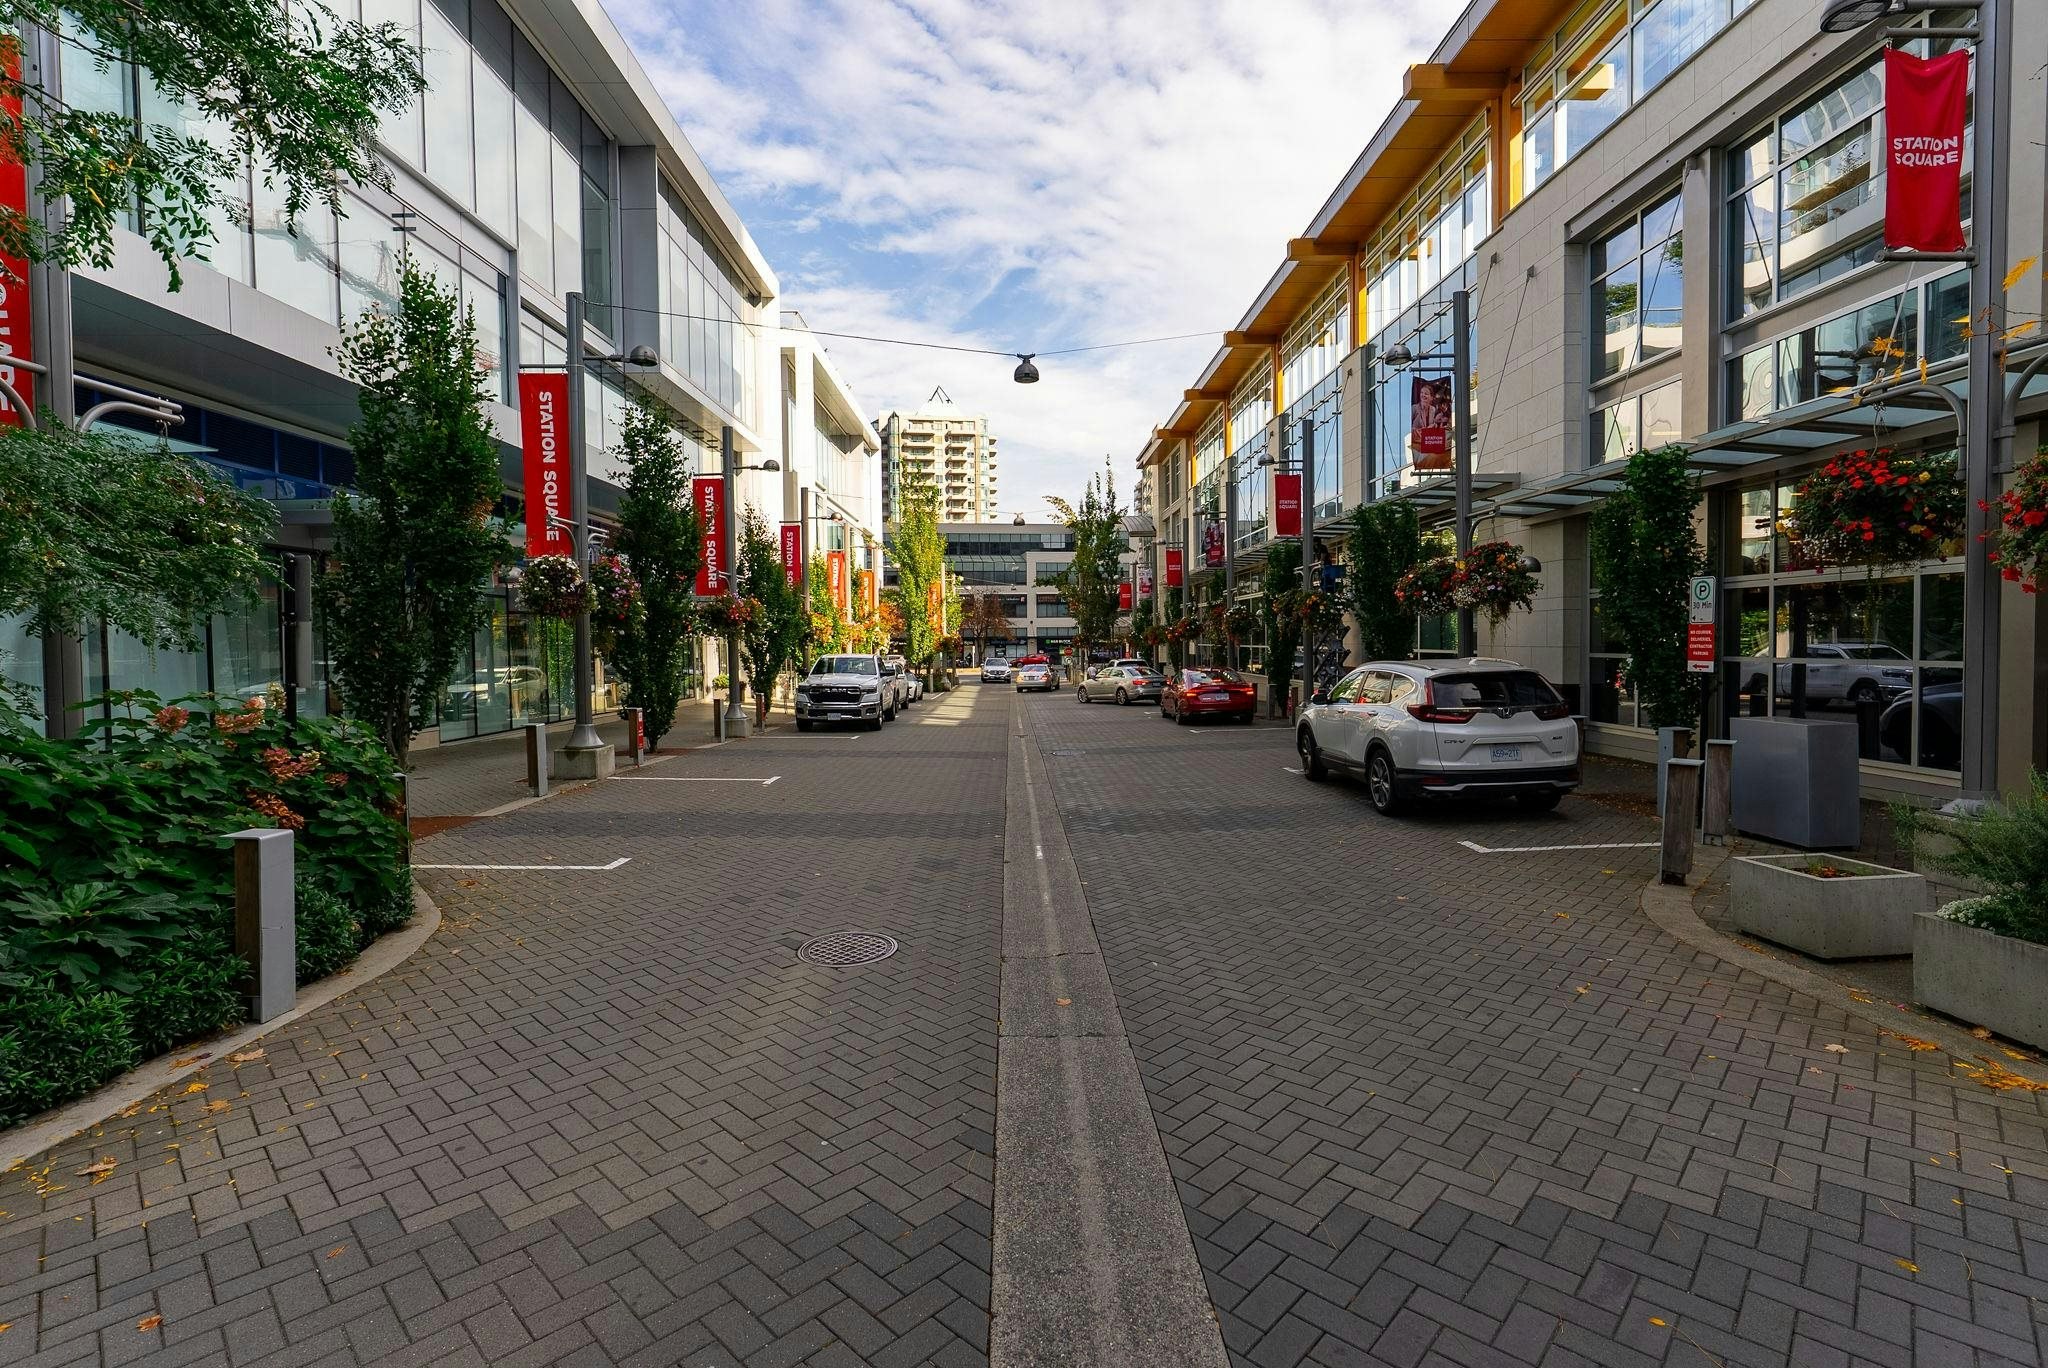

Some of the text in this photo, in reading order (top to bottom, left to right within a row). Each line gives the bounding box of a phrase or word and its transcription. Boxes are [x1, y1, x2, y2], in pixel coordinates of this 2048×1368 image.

[1893, 136, 1958, 152] STATION
[1894, 150, 1959, 167] SQUARE
[539, 391, 556, 463] STATION
[786, 531, 794, 567] STATION
[706, 540, 718, 589] SQUARE
[1699, 585, 1707, 596] P
[1701, 601, 1712, 609] Min
